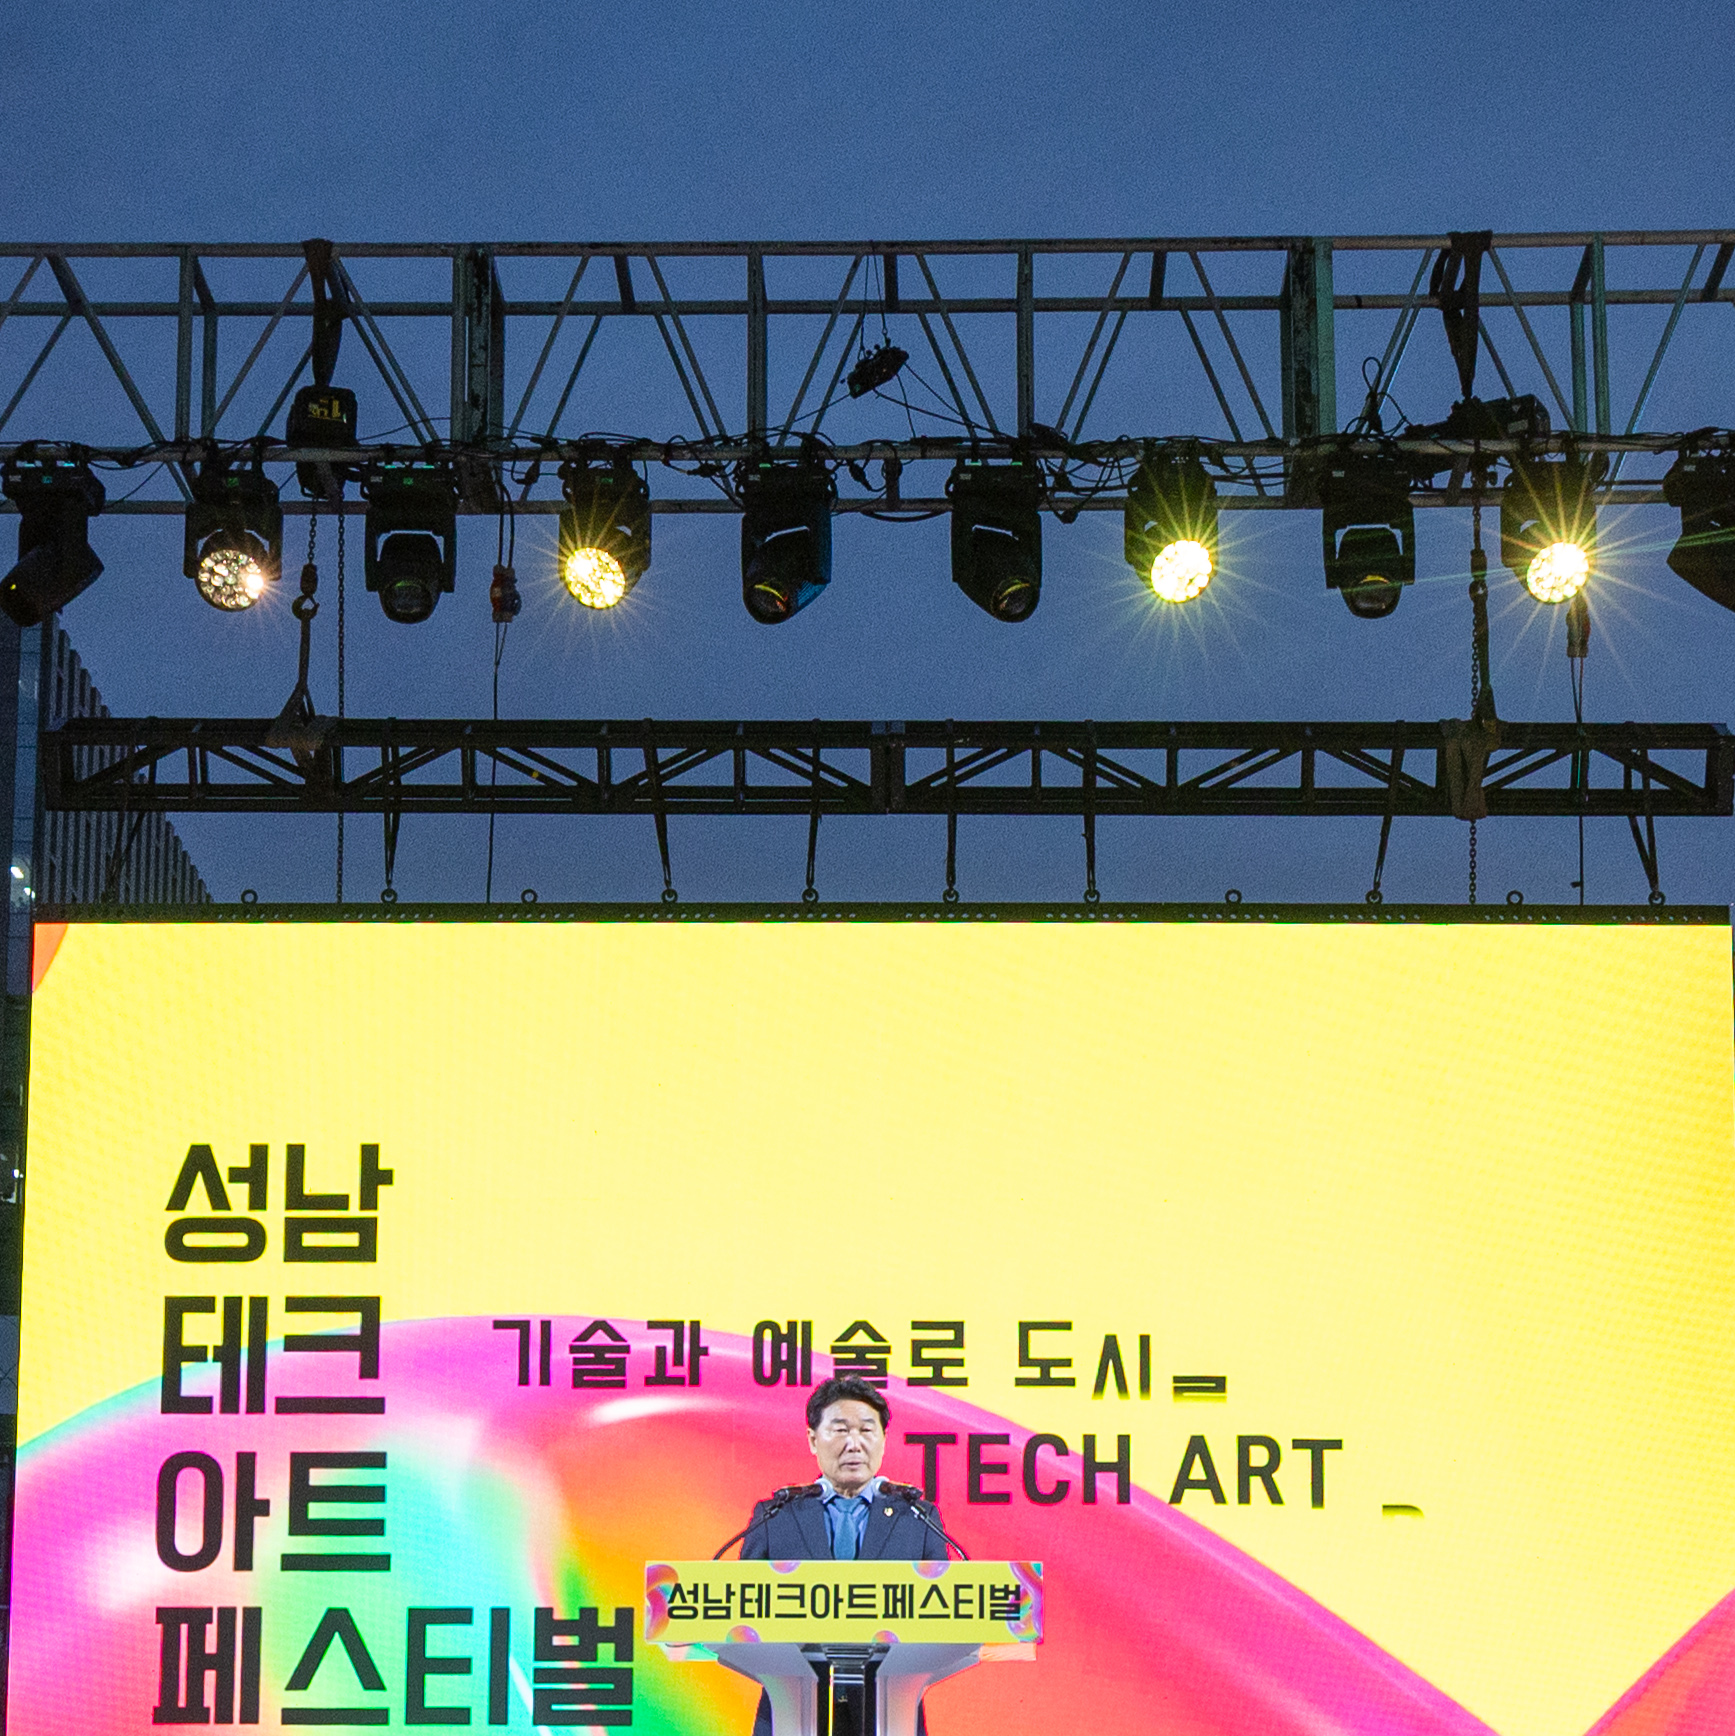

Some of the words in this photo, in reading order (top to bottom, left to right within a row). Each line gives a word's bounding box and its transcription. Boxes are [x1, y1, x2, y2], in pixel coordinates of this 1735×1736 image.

[164, 1143, 394, 1263] 성남
[160, 1295, 386, 1414] 테크
[492, 1319, 709, 1389] 기술과
[752, 1319, 968, 1389] 예술로
[156, 1450, 391, 1572] 아트
[904, 1432, 1131, 1505] TECH
[1168, 1434, 1343, 1509] ART
[667, 1582, 1022, 1622] 성남테크아트페스티벌
[152, 1606, 635, 1727] 페스티벌
